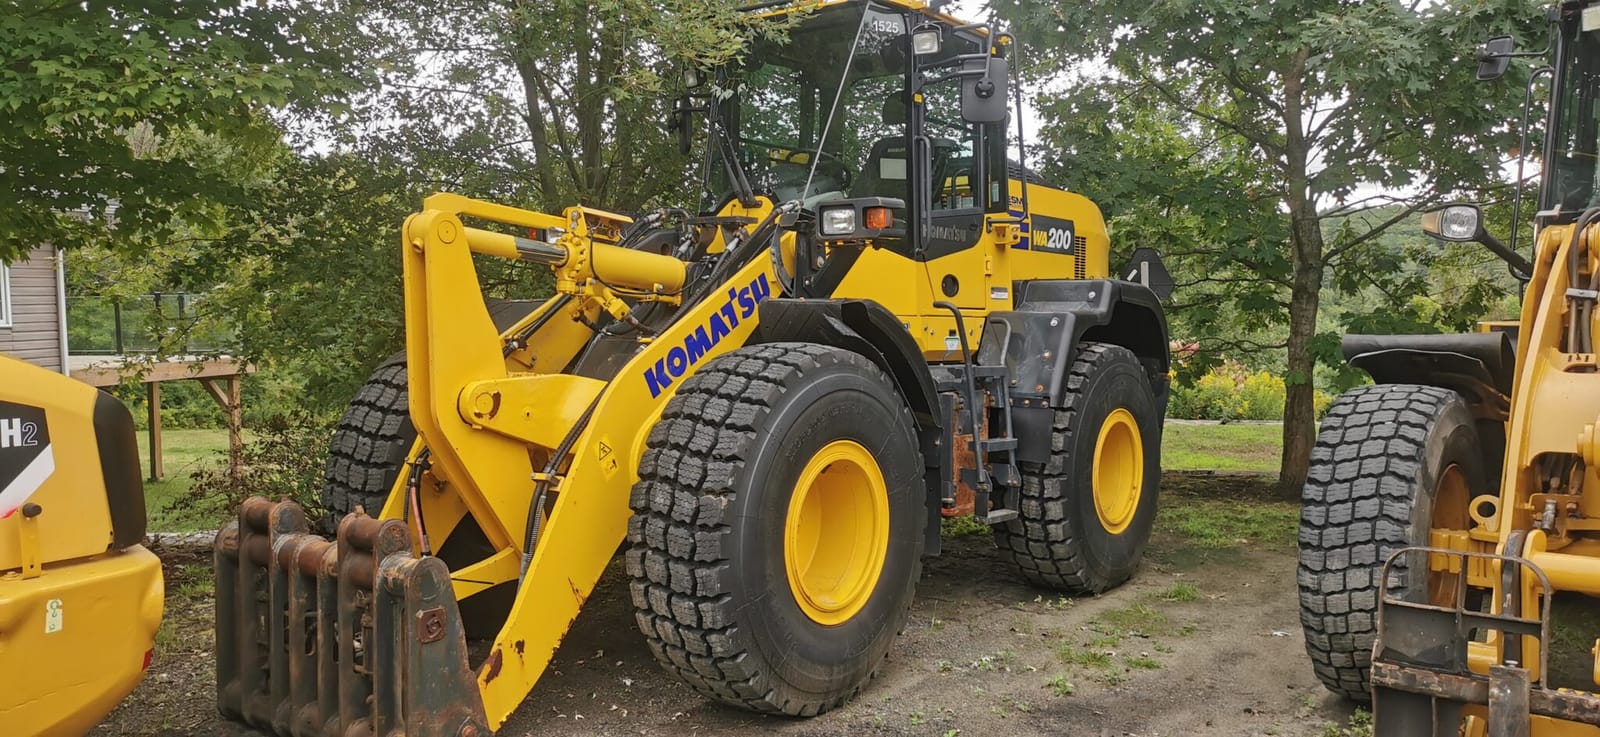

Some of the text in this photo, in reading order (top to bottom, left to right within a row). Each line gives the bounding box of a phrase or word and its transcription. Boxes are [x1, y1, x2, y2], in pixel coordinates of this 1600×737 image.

[873, 20, 899, 34] 1525
[1033, 227, 1071, 249] WA200
[643, 272, 770, 399] KOMATSU
[1, 418, 38, 448] H2
